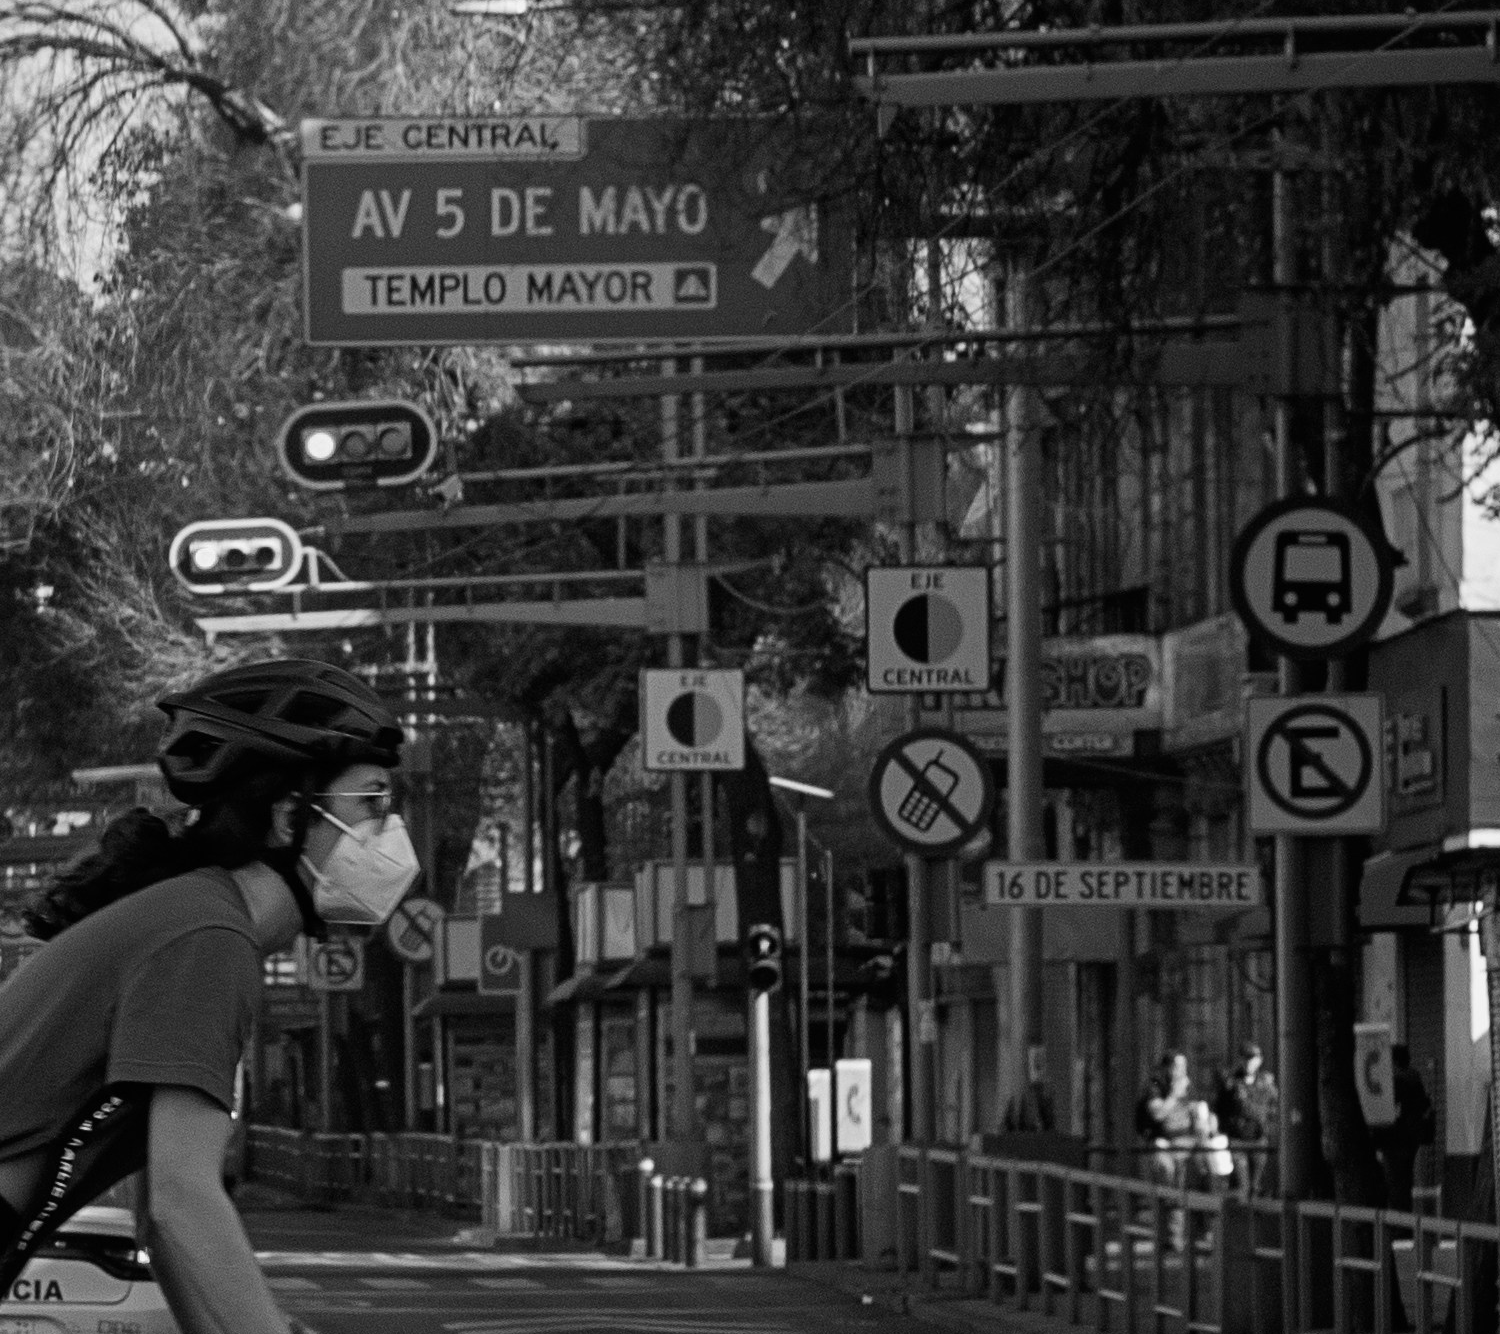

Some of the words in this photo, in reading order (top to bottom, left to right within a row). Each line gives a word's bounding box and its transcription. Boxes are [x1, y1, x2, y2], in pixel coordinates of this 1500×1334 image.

[320, 124, 384, 152] EJE
[402, 122, 558, 150] CENTRAL
[351, 188, 412, 239] AV
[436, 187, 466, 238] 5
[490, 186, 556, 237] DE
[578, 183, 709, 236] MAYO
[365, 273, 507, 307] TEMPLO
[526, 270, 654, 305] MAYOR
[911, 571, 946, 590] EJE
[882, 667, 976, 687] CENTRAL
[656, 750, 732, 765] CENTRAL
[996, 873, 1024, 900] 16
[1036, 872, 1071, 900] DE
[1079, 869, 1252, 900] SEPTIEMBRE
